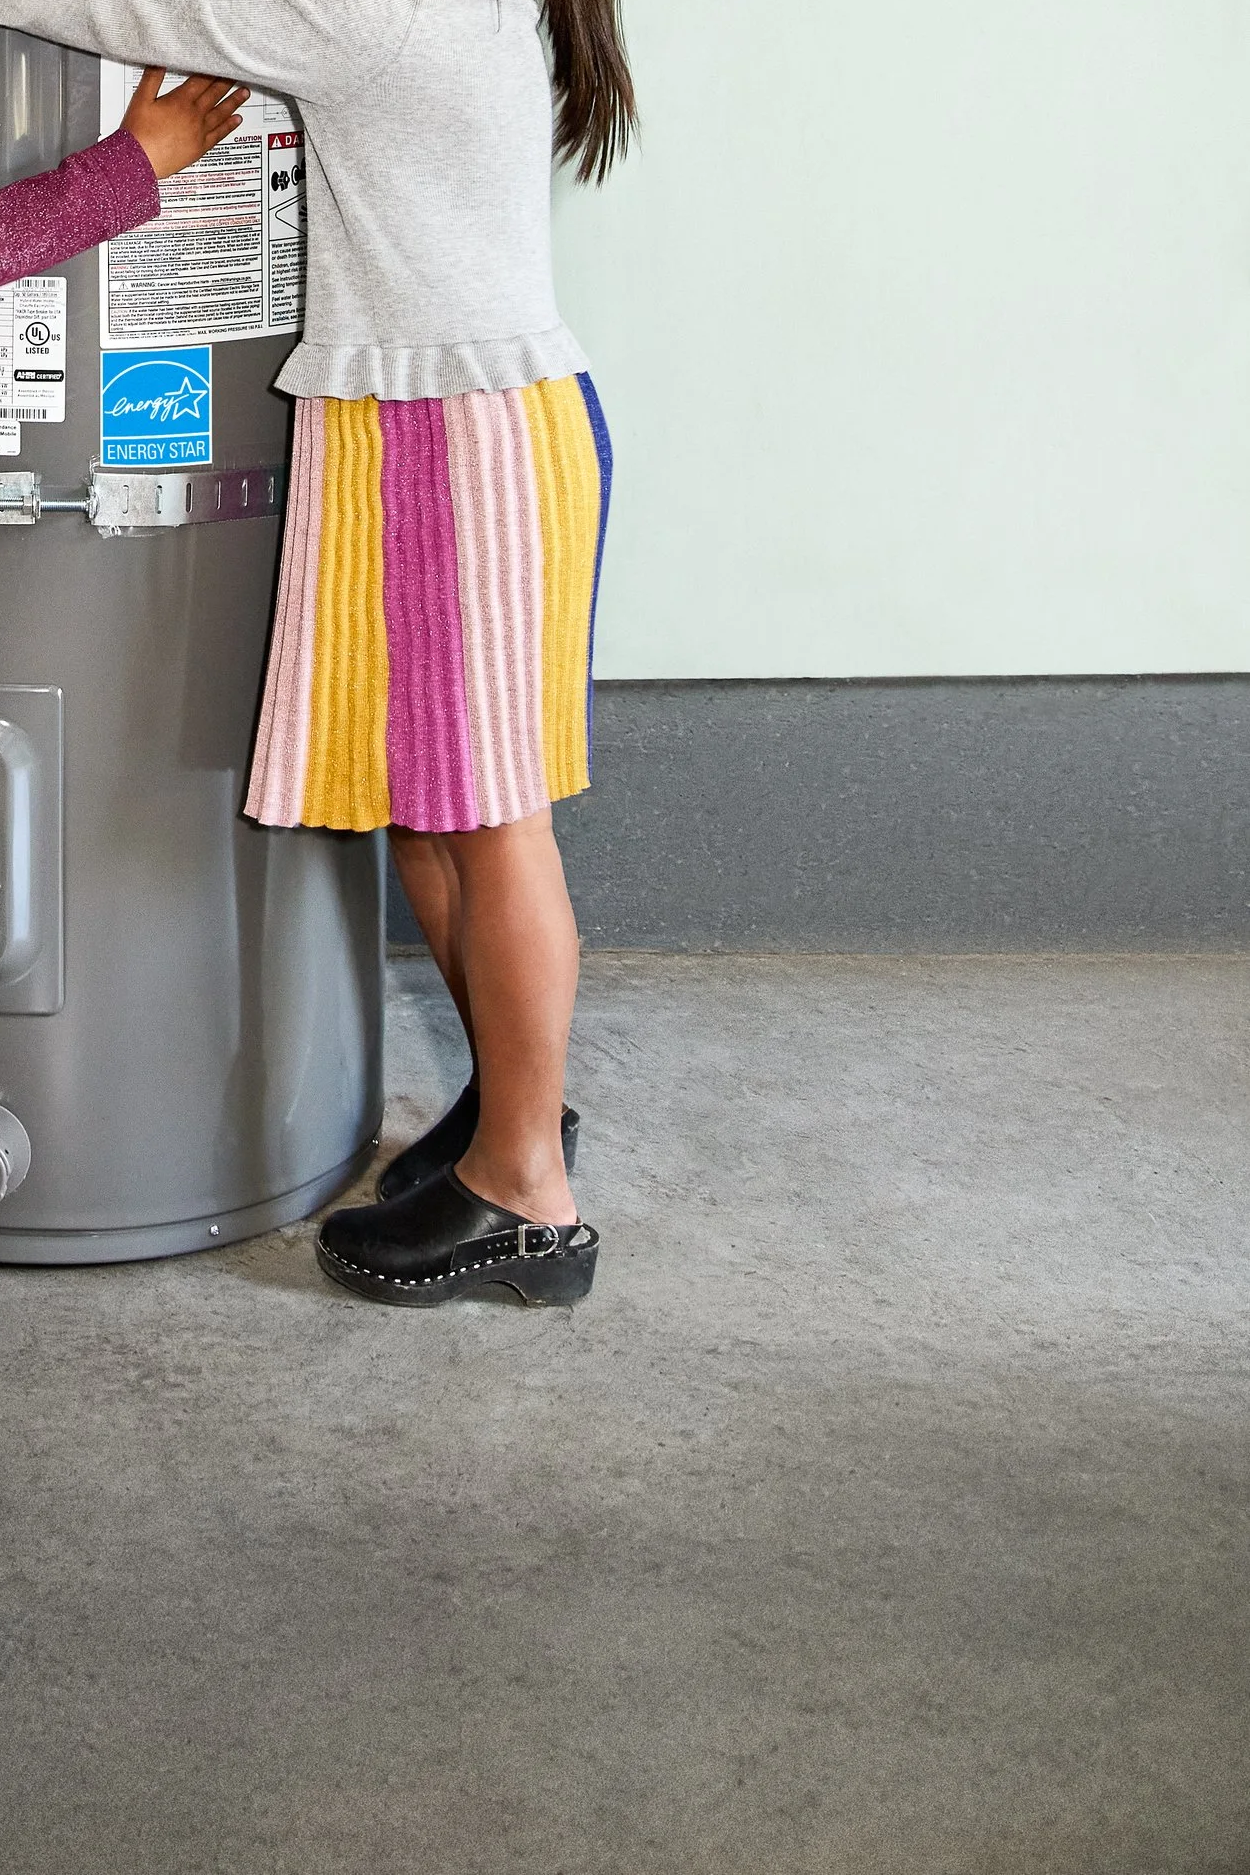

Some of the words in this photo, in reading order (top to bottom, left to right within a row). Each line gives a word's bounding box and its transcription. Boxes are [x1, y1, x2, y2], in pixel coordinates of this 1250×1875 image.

[31, 327, 44, 340] UL
[26, 347, 49, 355] LISTED
[105, 395, 184, 422] energy
[108, 443, 166, 459] ENERGY
[170, 441, 205, 458] STAR
